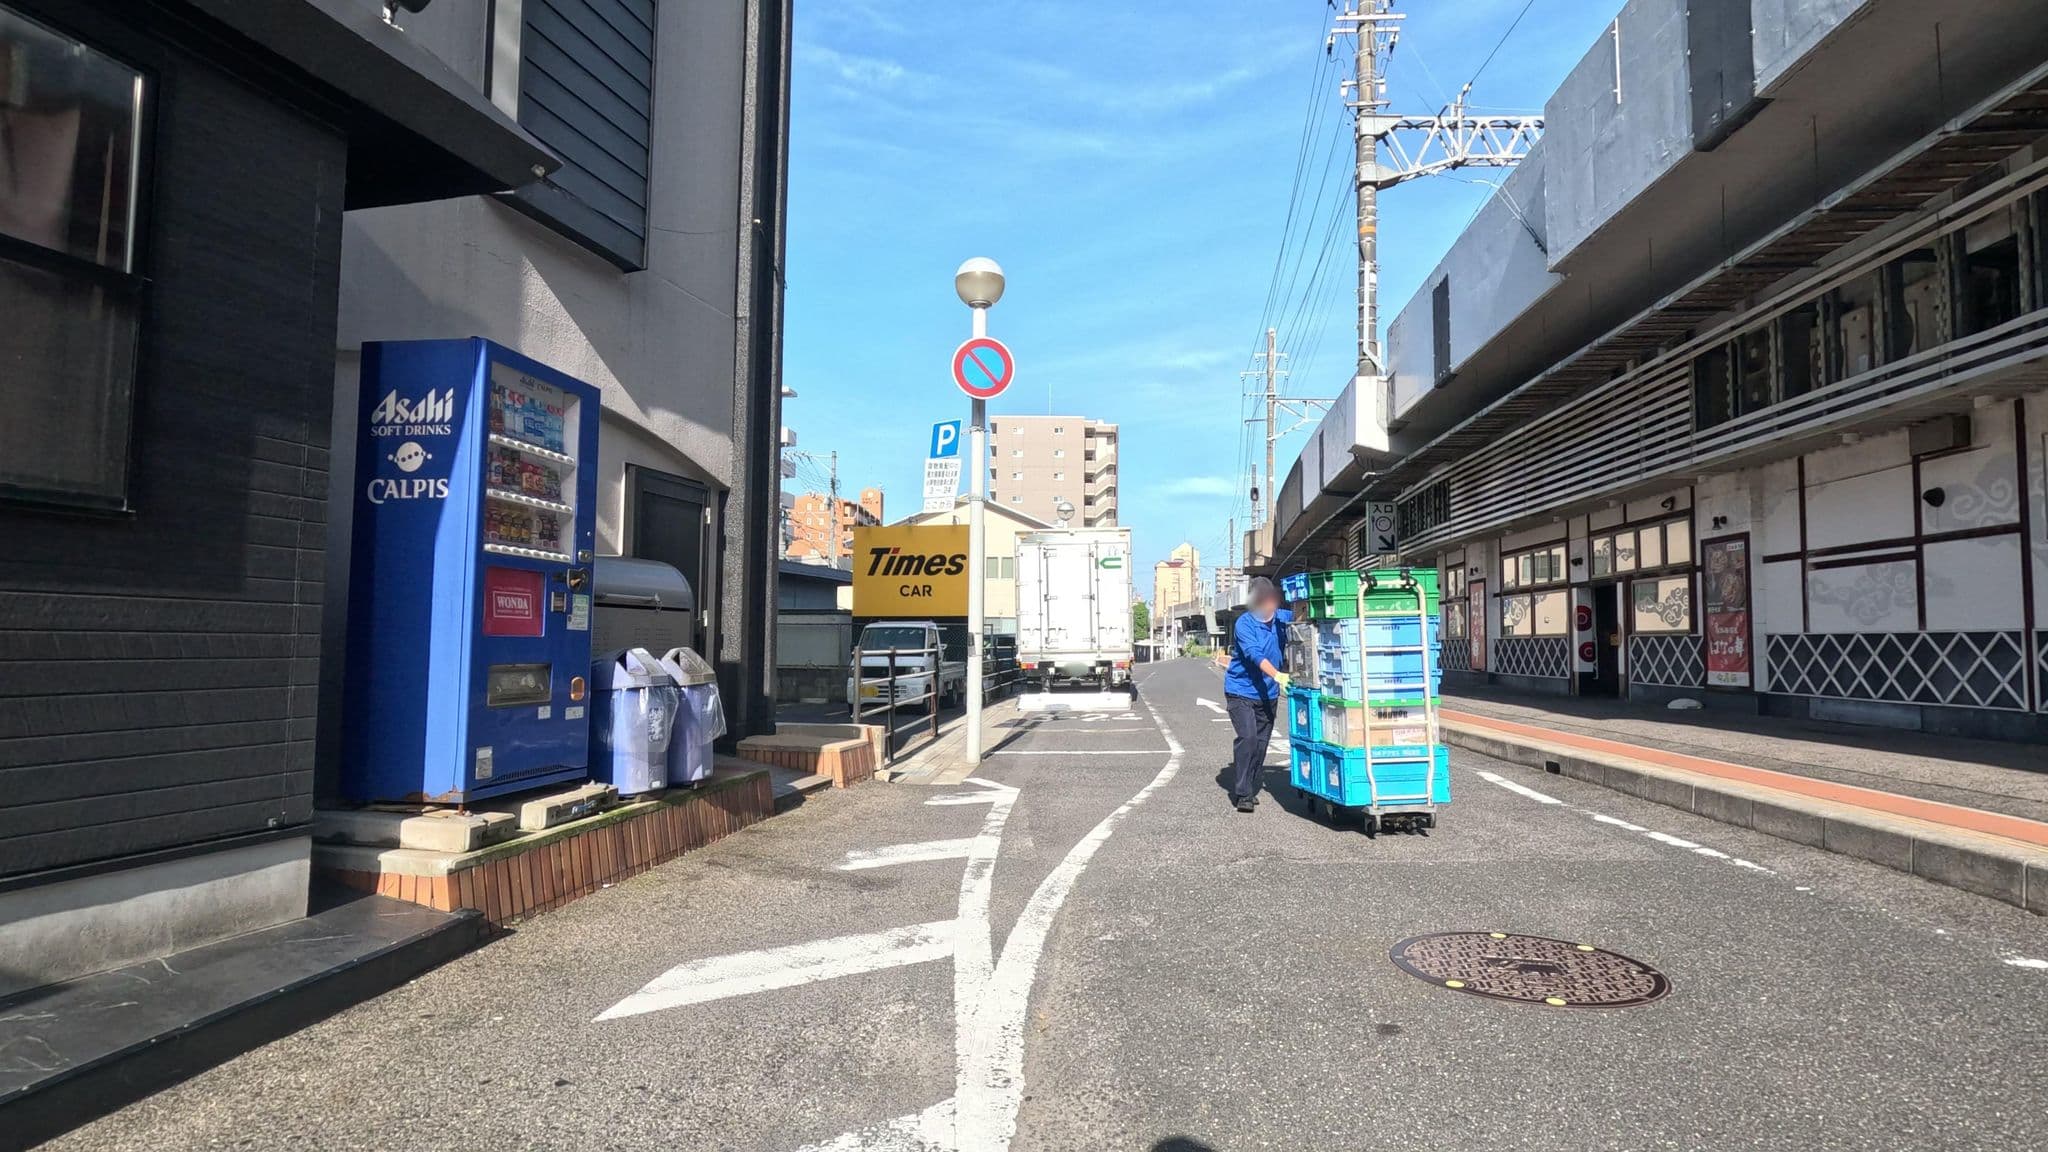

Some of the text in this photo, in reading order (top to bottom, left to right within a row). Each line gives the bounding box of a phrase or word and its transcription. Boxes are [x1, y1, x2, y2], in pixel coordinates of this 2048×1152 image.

[371, 388, 454, 424] Asahi
[371, 424, 451, 436] SOFT DRINKS
[936, 424, 956, 455] P
[367, 478, 449, 504] CALPIS
[1373, 504, 1393, 513] 入口
[867, 547, 967, 576] Times
[900, 584, 932, 597] CAR
[497, 596, 529, 609] WONDA
